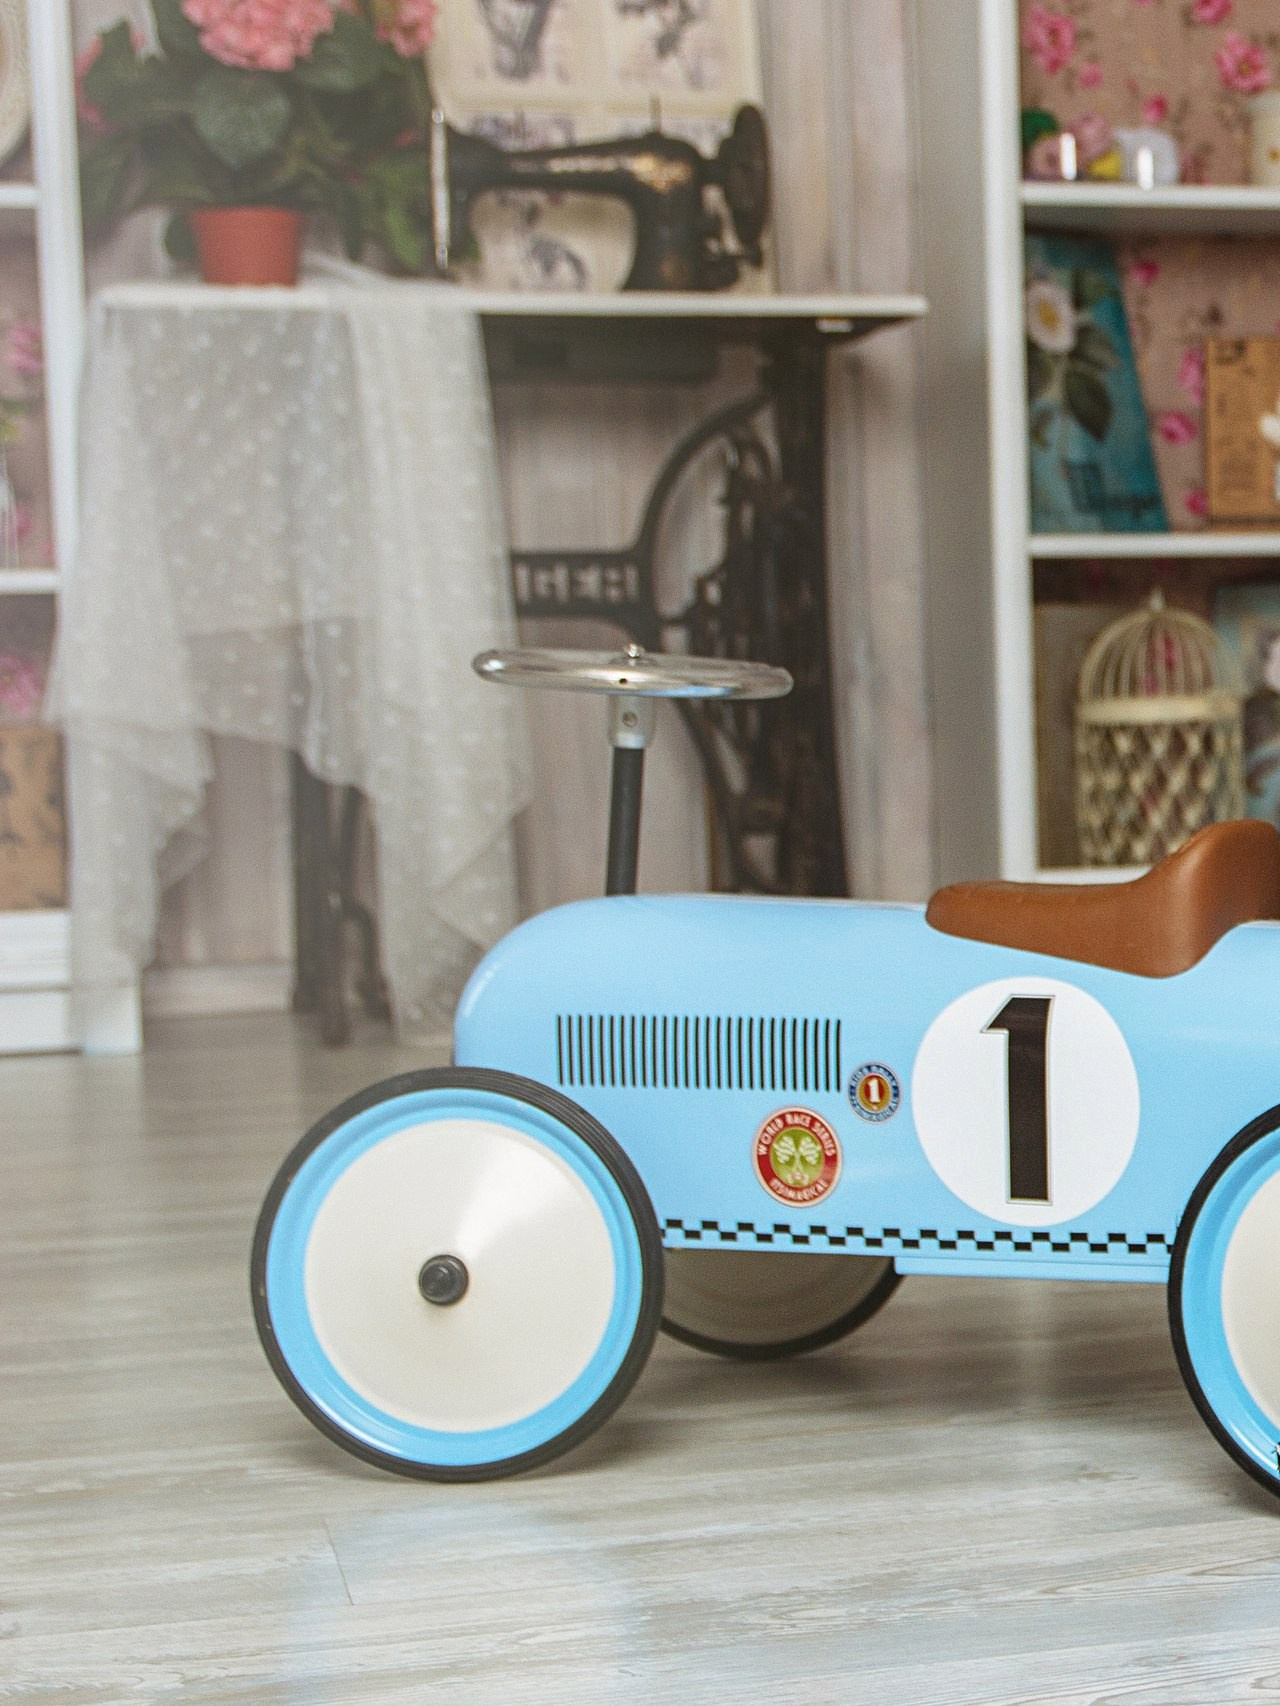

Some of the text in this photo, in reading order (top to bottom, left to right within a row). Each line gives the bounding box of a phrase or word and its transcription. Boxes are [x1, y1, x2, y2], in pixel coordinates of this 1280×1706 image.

[867, 1079, 881, 1103] 1
[982, 995, 1055, 1205] 1
[757, 1113, 836, 1157] WORLD RACE SERIES
